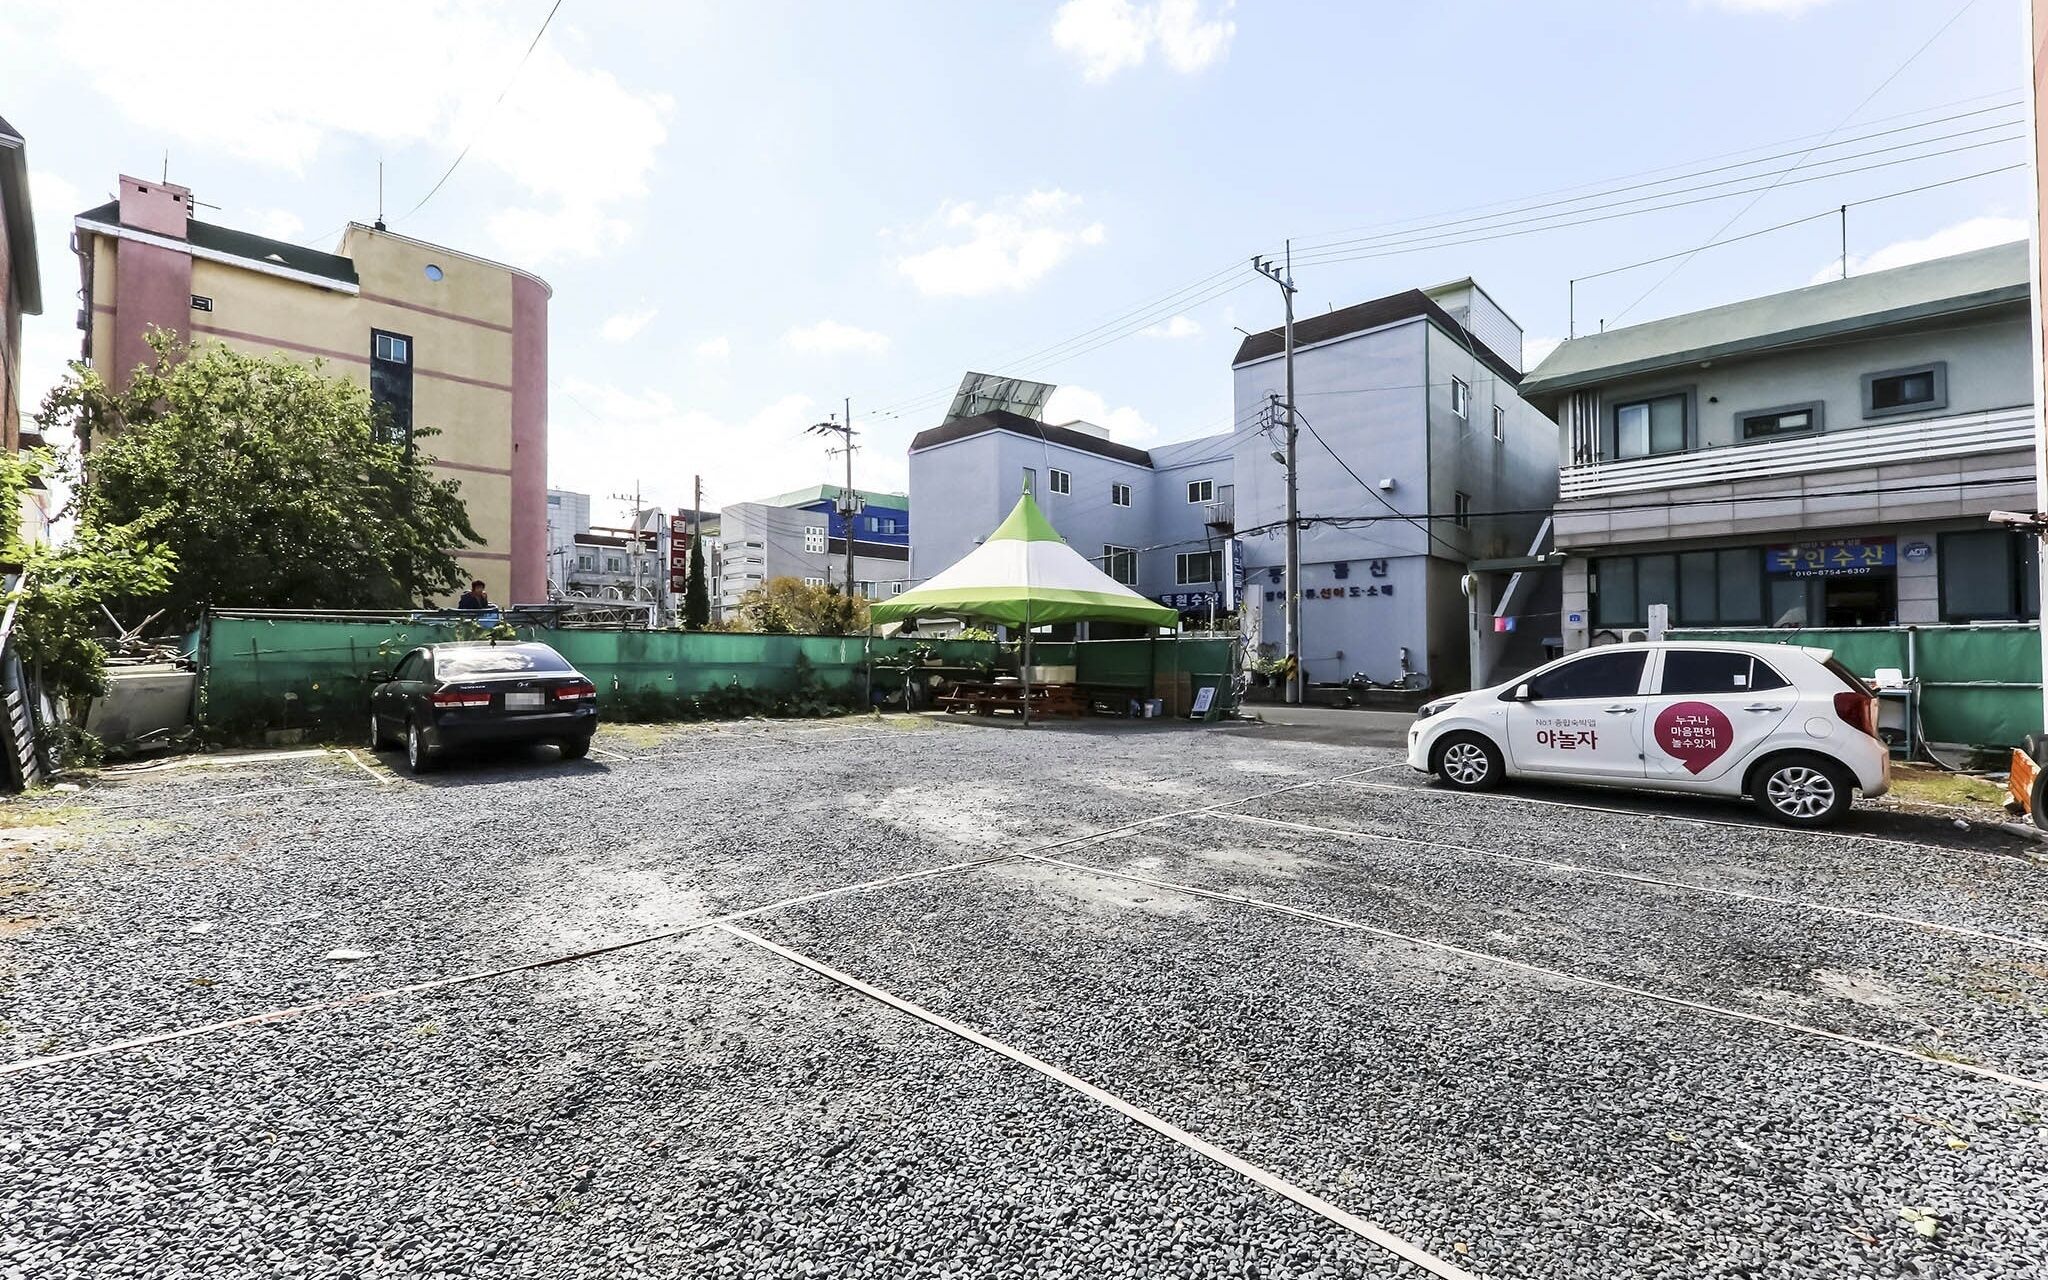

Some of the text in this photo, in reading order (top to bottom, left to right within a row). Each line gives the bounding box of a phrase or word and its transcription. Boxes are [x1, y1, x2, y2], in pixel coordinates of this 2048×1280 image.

[672, 520, 686, 588] 월드모텔
[1907, 547, 1929, 557] ADT
[1675, 715, 1710, 725] 누구나
[1671, 726, 1715, 737] 마음편히
[1536, 729, 1598, 750] 야놀자
[1672, 738, 1716, 749] 놀수있게
